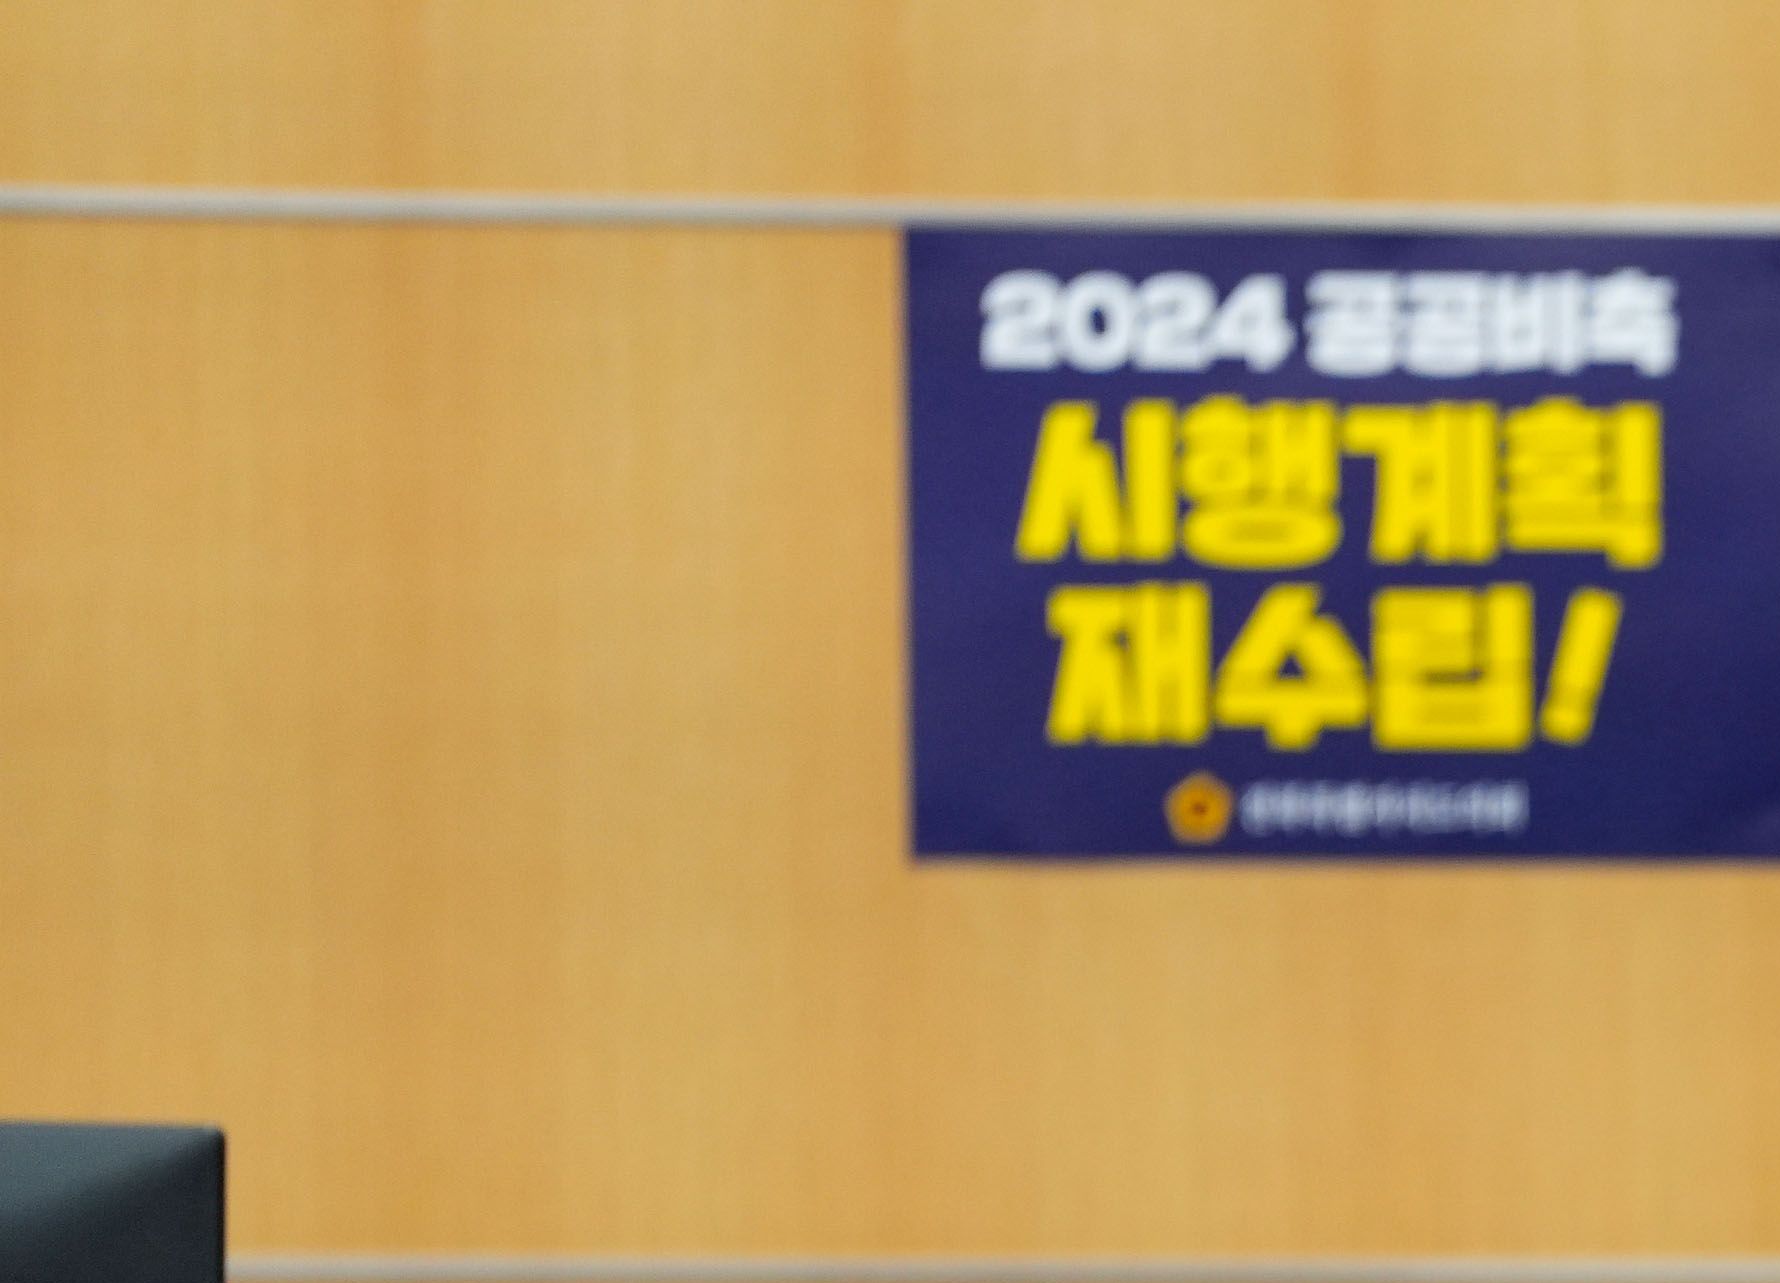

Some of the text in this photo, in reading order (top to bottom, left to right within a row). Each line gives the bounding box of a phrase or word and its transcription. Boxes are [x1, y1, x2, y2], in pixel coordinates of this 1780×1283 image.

[981, 268, 1678, 377] 2024 공공비축
[1017, 395, 1661, 569] 시행계획
[1047, 582, 1620, 750] 재수립!
